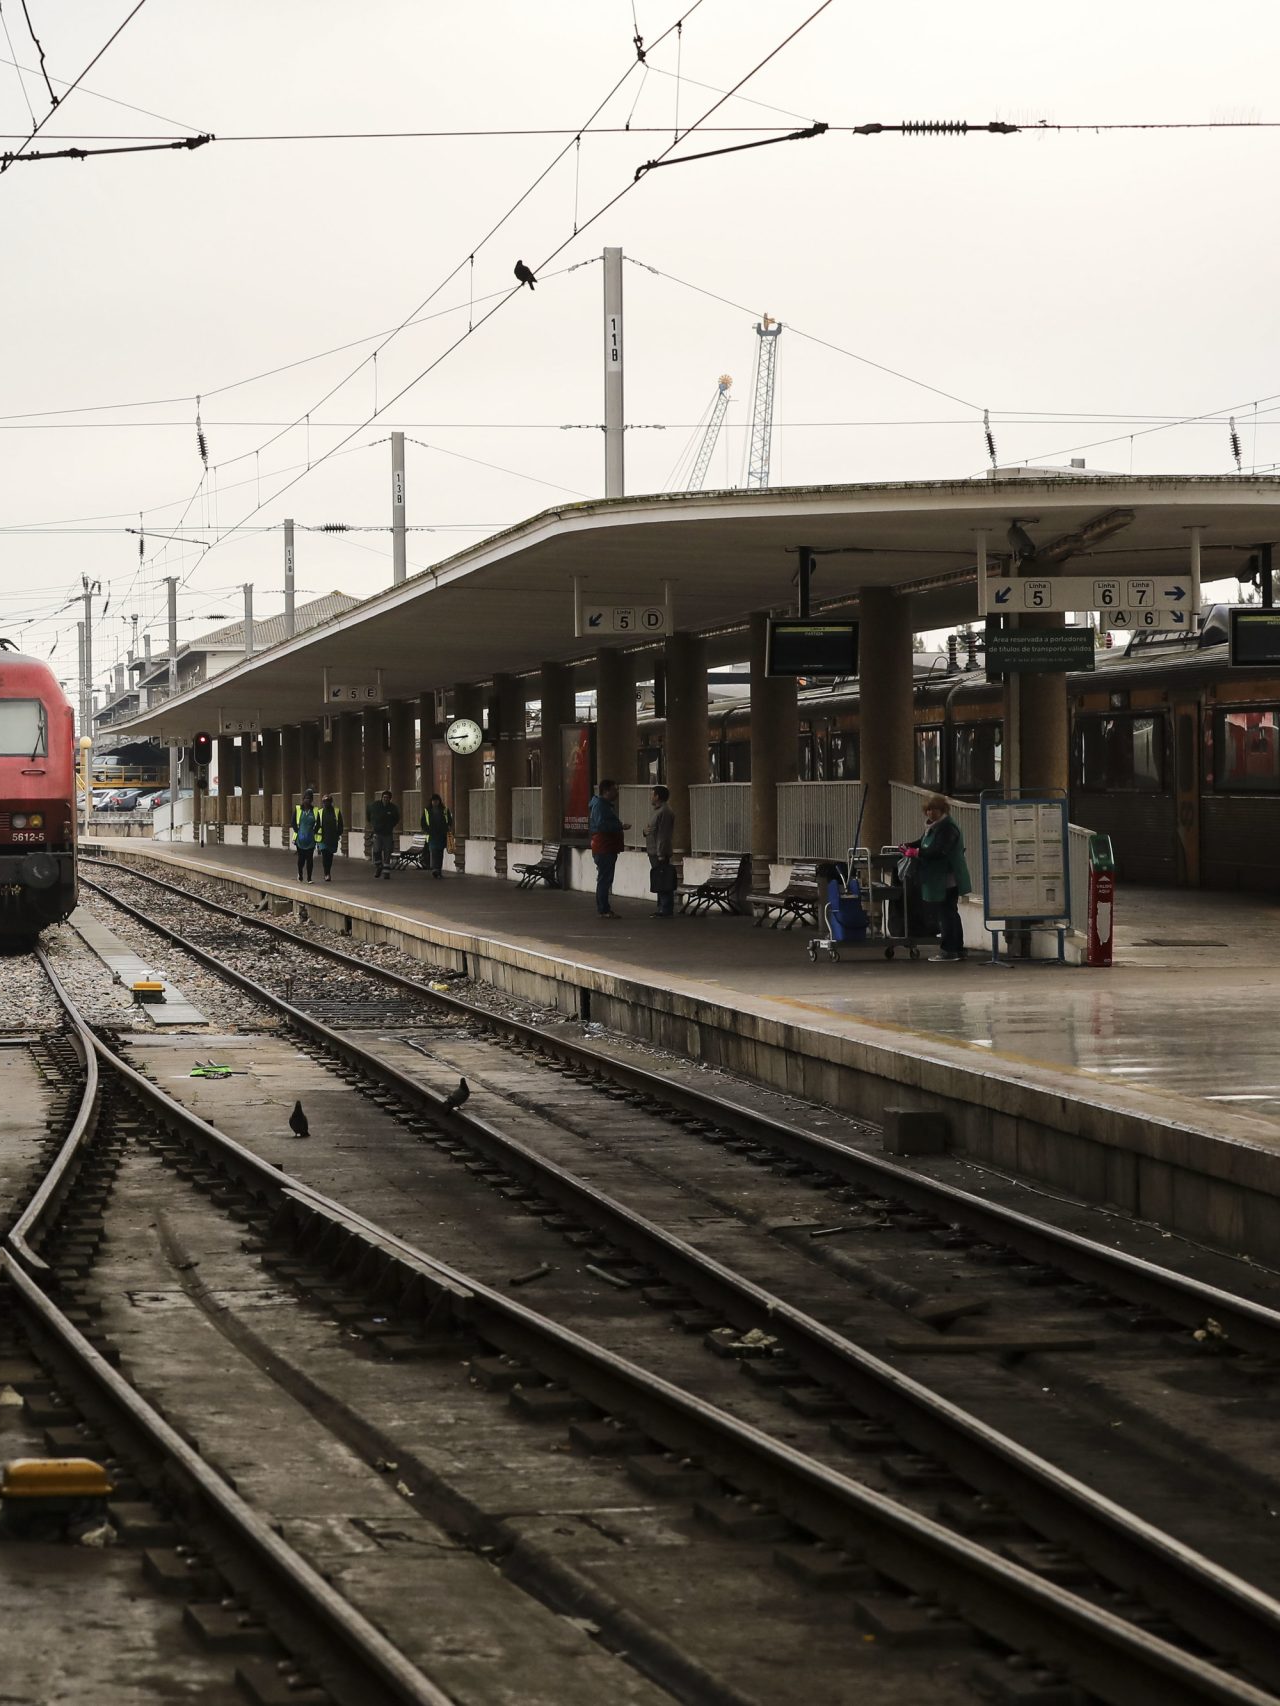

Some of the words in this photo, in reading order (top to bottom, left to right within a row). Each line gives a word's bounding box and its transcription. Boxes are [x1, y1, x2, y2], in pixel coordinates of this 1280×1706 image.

[1033, 590, 1044, 606] 5
[1101, 588, 1113, 604] 6
[1136, 590, 1146, 604] 7
[620, 616, 629, 628] 5
[648, 614, 658, 626] D
[1114, 611, 1126, 623] A
[1145, 612, 1154, 625] 6
[368, 688, 374, 697] E
[12, 833, 45, 841] 5612-5
